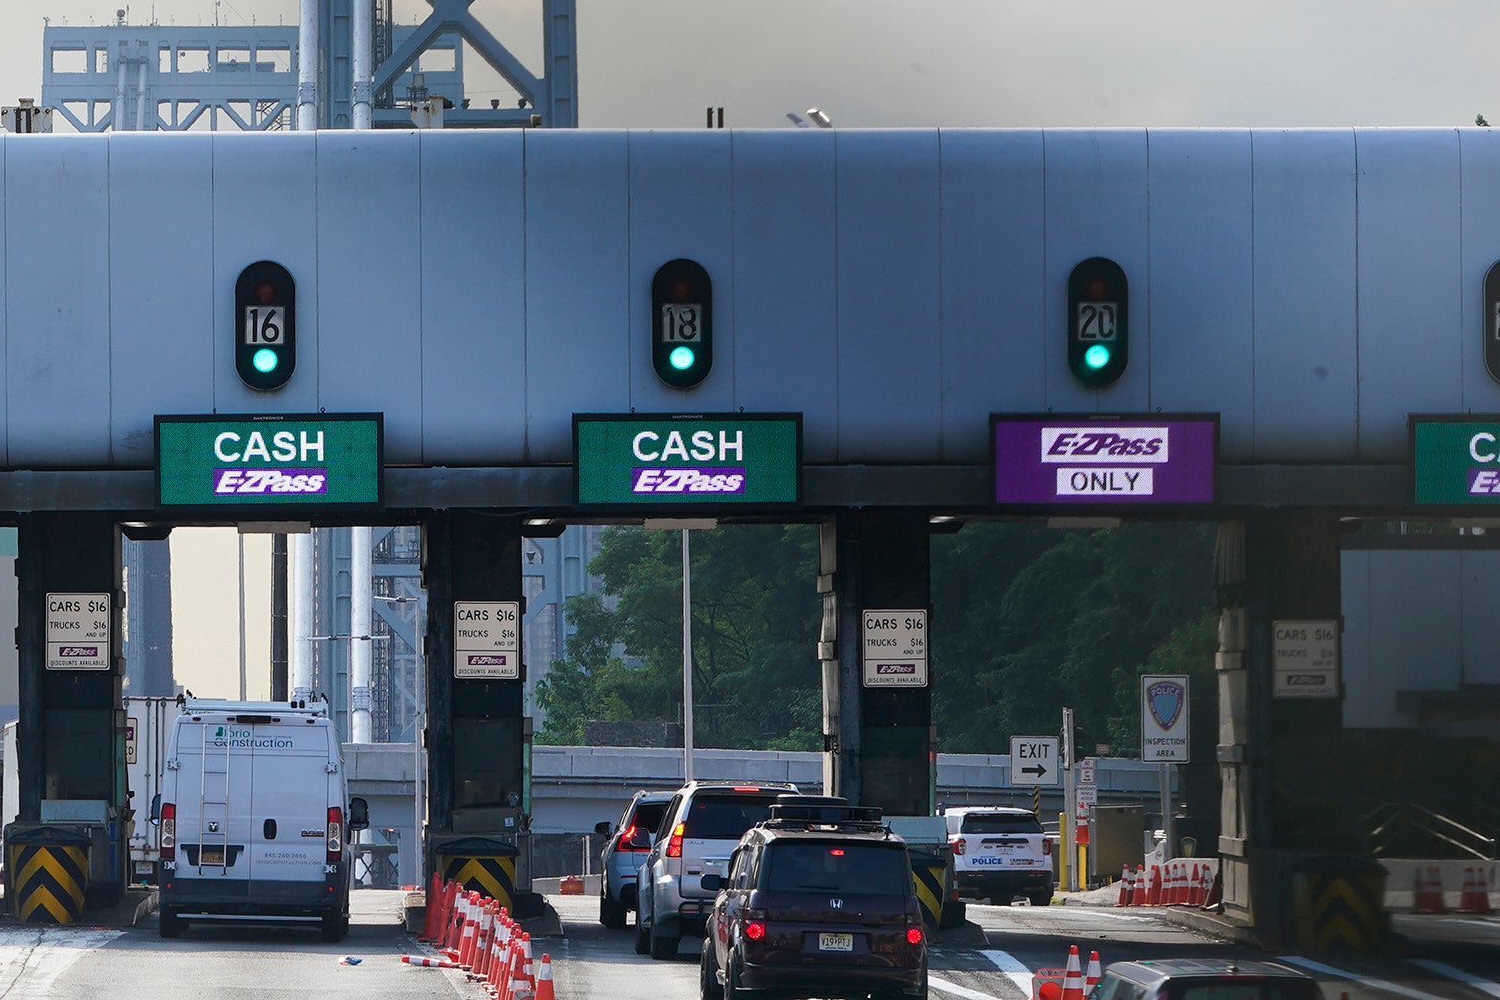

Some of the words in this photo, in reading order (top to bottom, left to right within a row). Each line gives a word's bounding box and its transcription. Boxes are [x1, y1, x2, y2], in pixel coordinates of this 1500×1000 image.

[250, 309, 279, 342] 16
[667, 306, 696, 340] 18
[1081, 305, 1114, 338] 20
[214, 431, 324, 462] CASH
[633, 430, 743, 461] CASH
[1071, 472, 1139, 491] ONLY
[50, 601, 80, 612] CARS
[88, 600, 106, 613] $16
[458, 610, 489, 620] CARS
[496, 609, 515, 622] $16
[50, 621, 80, 629] TRUCKS
[93, 621, 106, 630] $16
[866, 619, 897, 629] CARS
[905, 617, 923, 630] $16
[458, 629, 489, 637] TRUCKS
[501, 629, 515, 638] $16
[1276, 629, 1307, 640] CARS
[910, 638, 924, 646] $16
[1150, 687, 1181, 697] POLICE
[214, 738, 293, 748] Construction
[1020, 744, 1050, 758] EXIT
[972, 857, 1003, 865] POLICE
